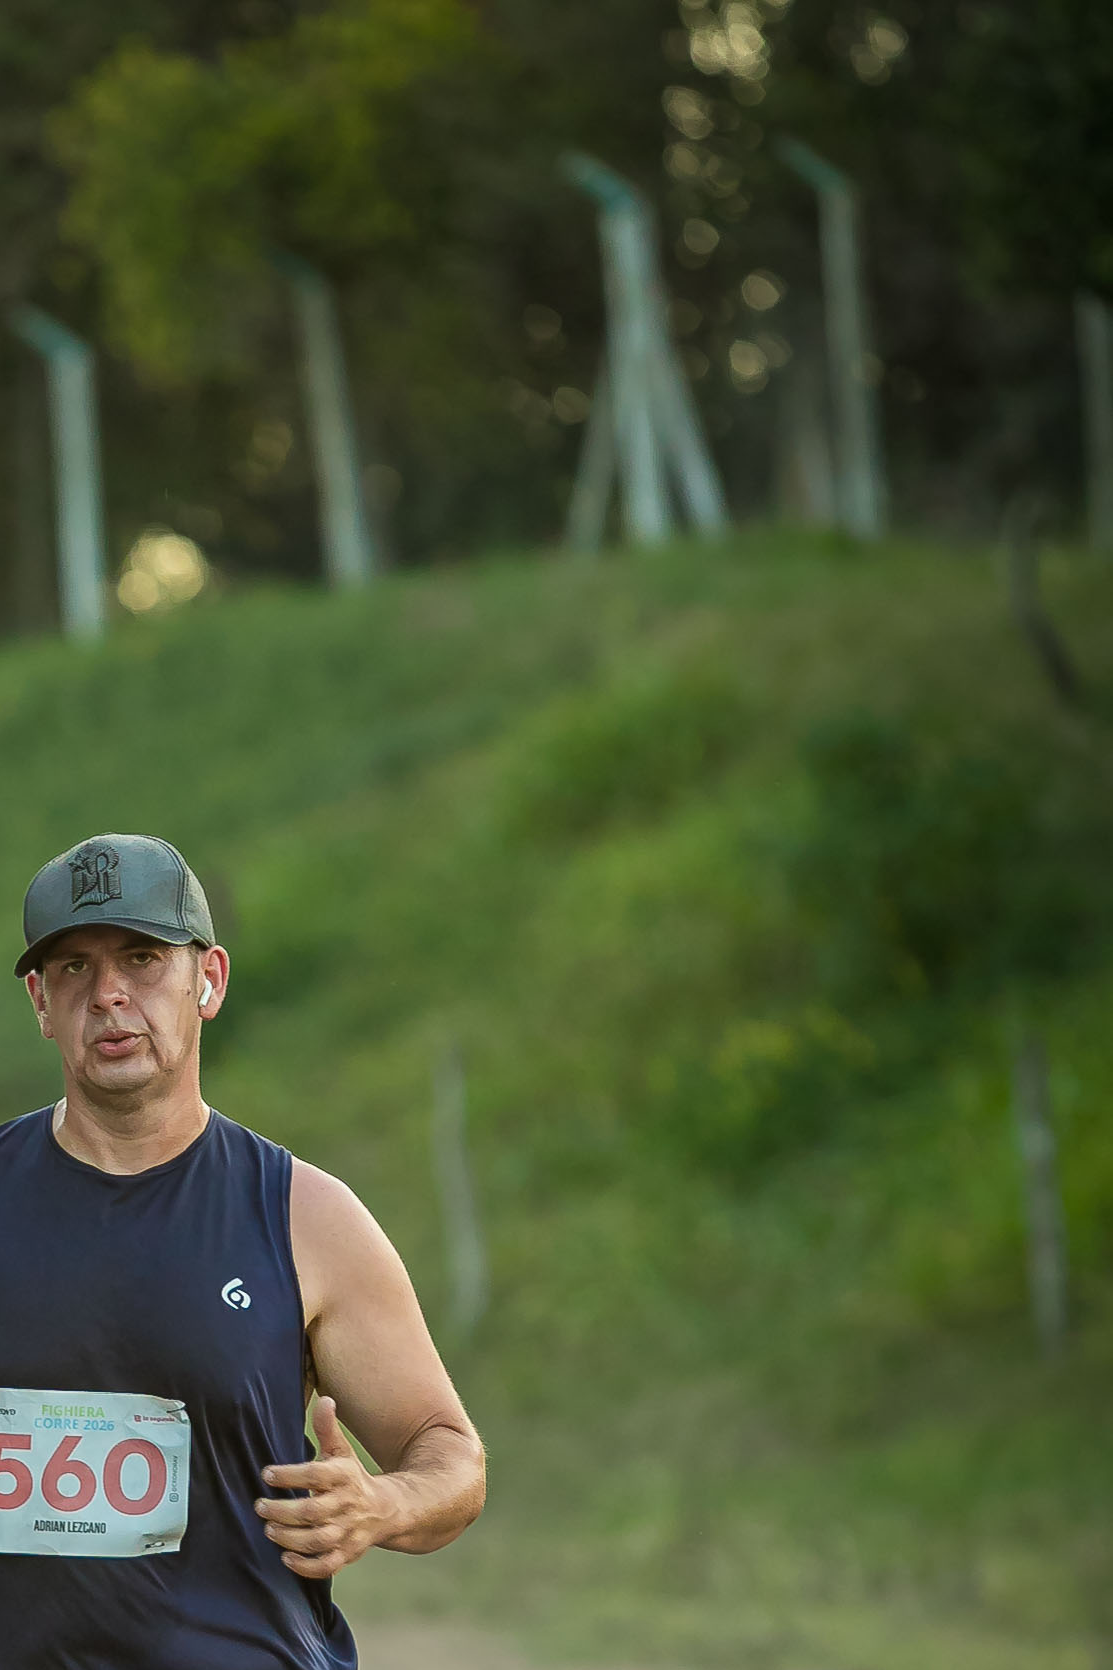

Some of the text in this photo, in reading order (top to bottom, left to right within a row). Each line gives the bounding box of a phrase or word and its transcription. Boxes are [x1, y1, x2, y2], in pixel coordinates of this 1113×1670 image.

[41, 1404, 105, 1418] FIGHIERA
[34, 1417, 115, 1431] CORRE 2026
[33, 1520, 107, 1534] ADRIAN LEZCANO
